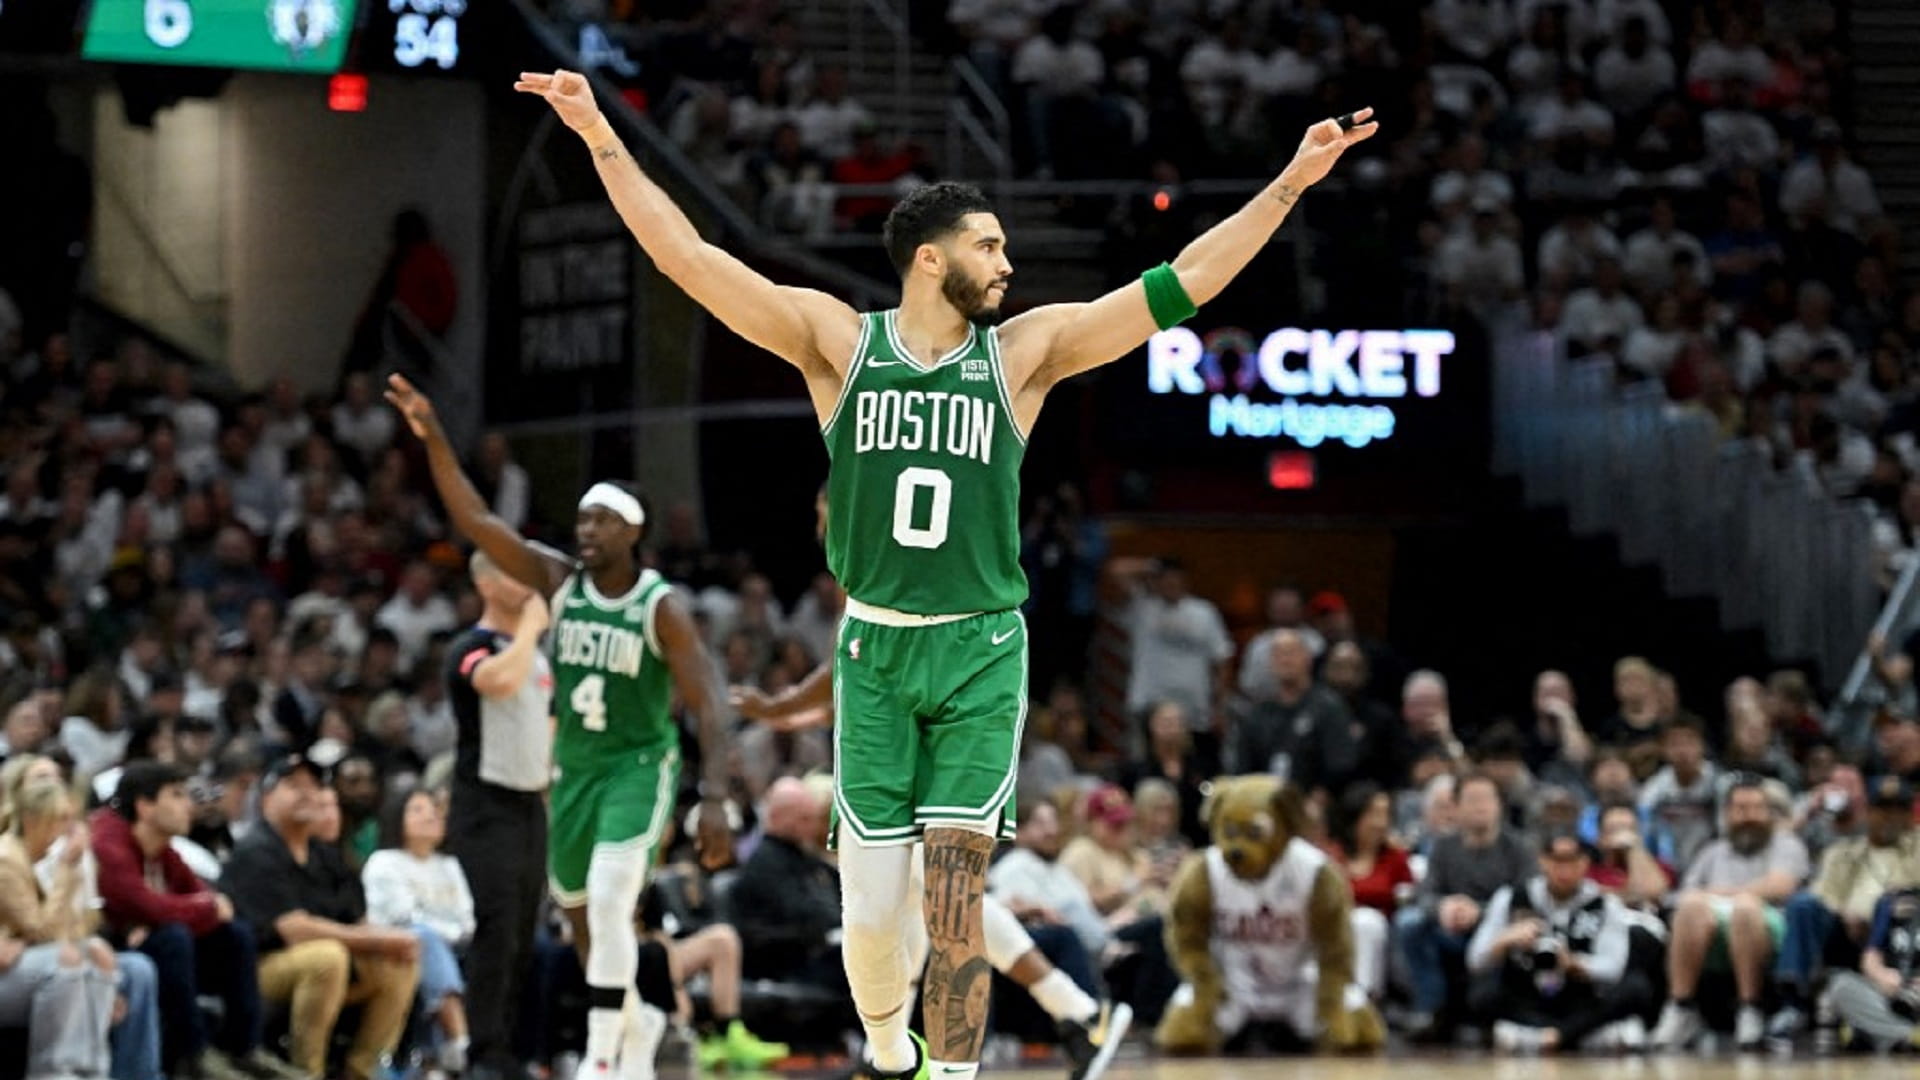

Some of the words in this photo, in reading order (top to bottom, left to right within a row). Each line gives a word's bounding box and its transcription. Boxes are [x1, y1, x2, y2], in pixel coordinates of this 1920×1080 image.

[394, 13, 459, 69] 54
[960, 359, 989, 372] VISTA
[961, 372, 989, 382] PRINT
[1148, 326, 1456, 398] ROCKET
[856, 389, 996, 465] BOSTON
[1208, 393, 1396, 448] Mortgage
[892, 466, 952, 550] 0
[558, 619, 644, 679] BOSTON
[570, 673, 607, 732] 4
